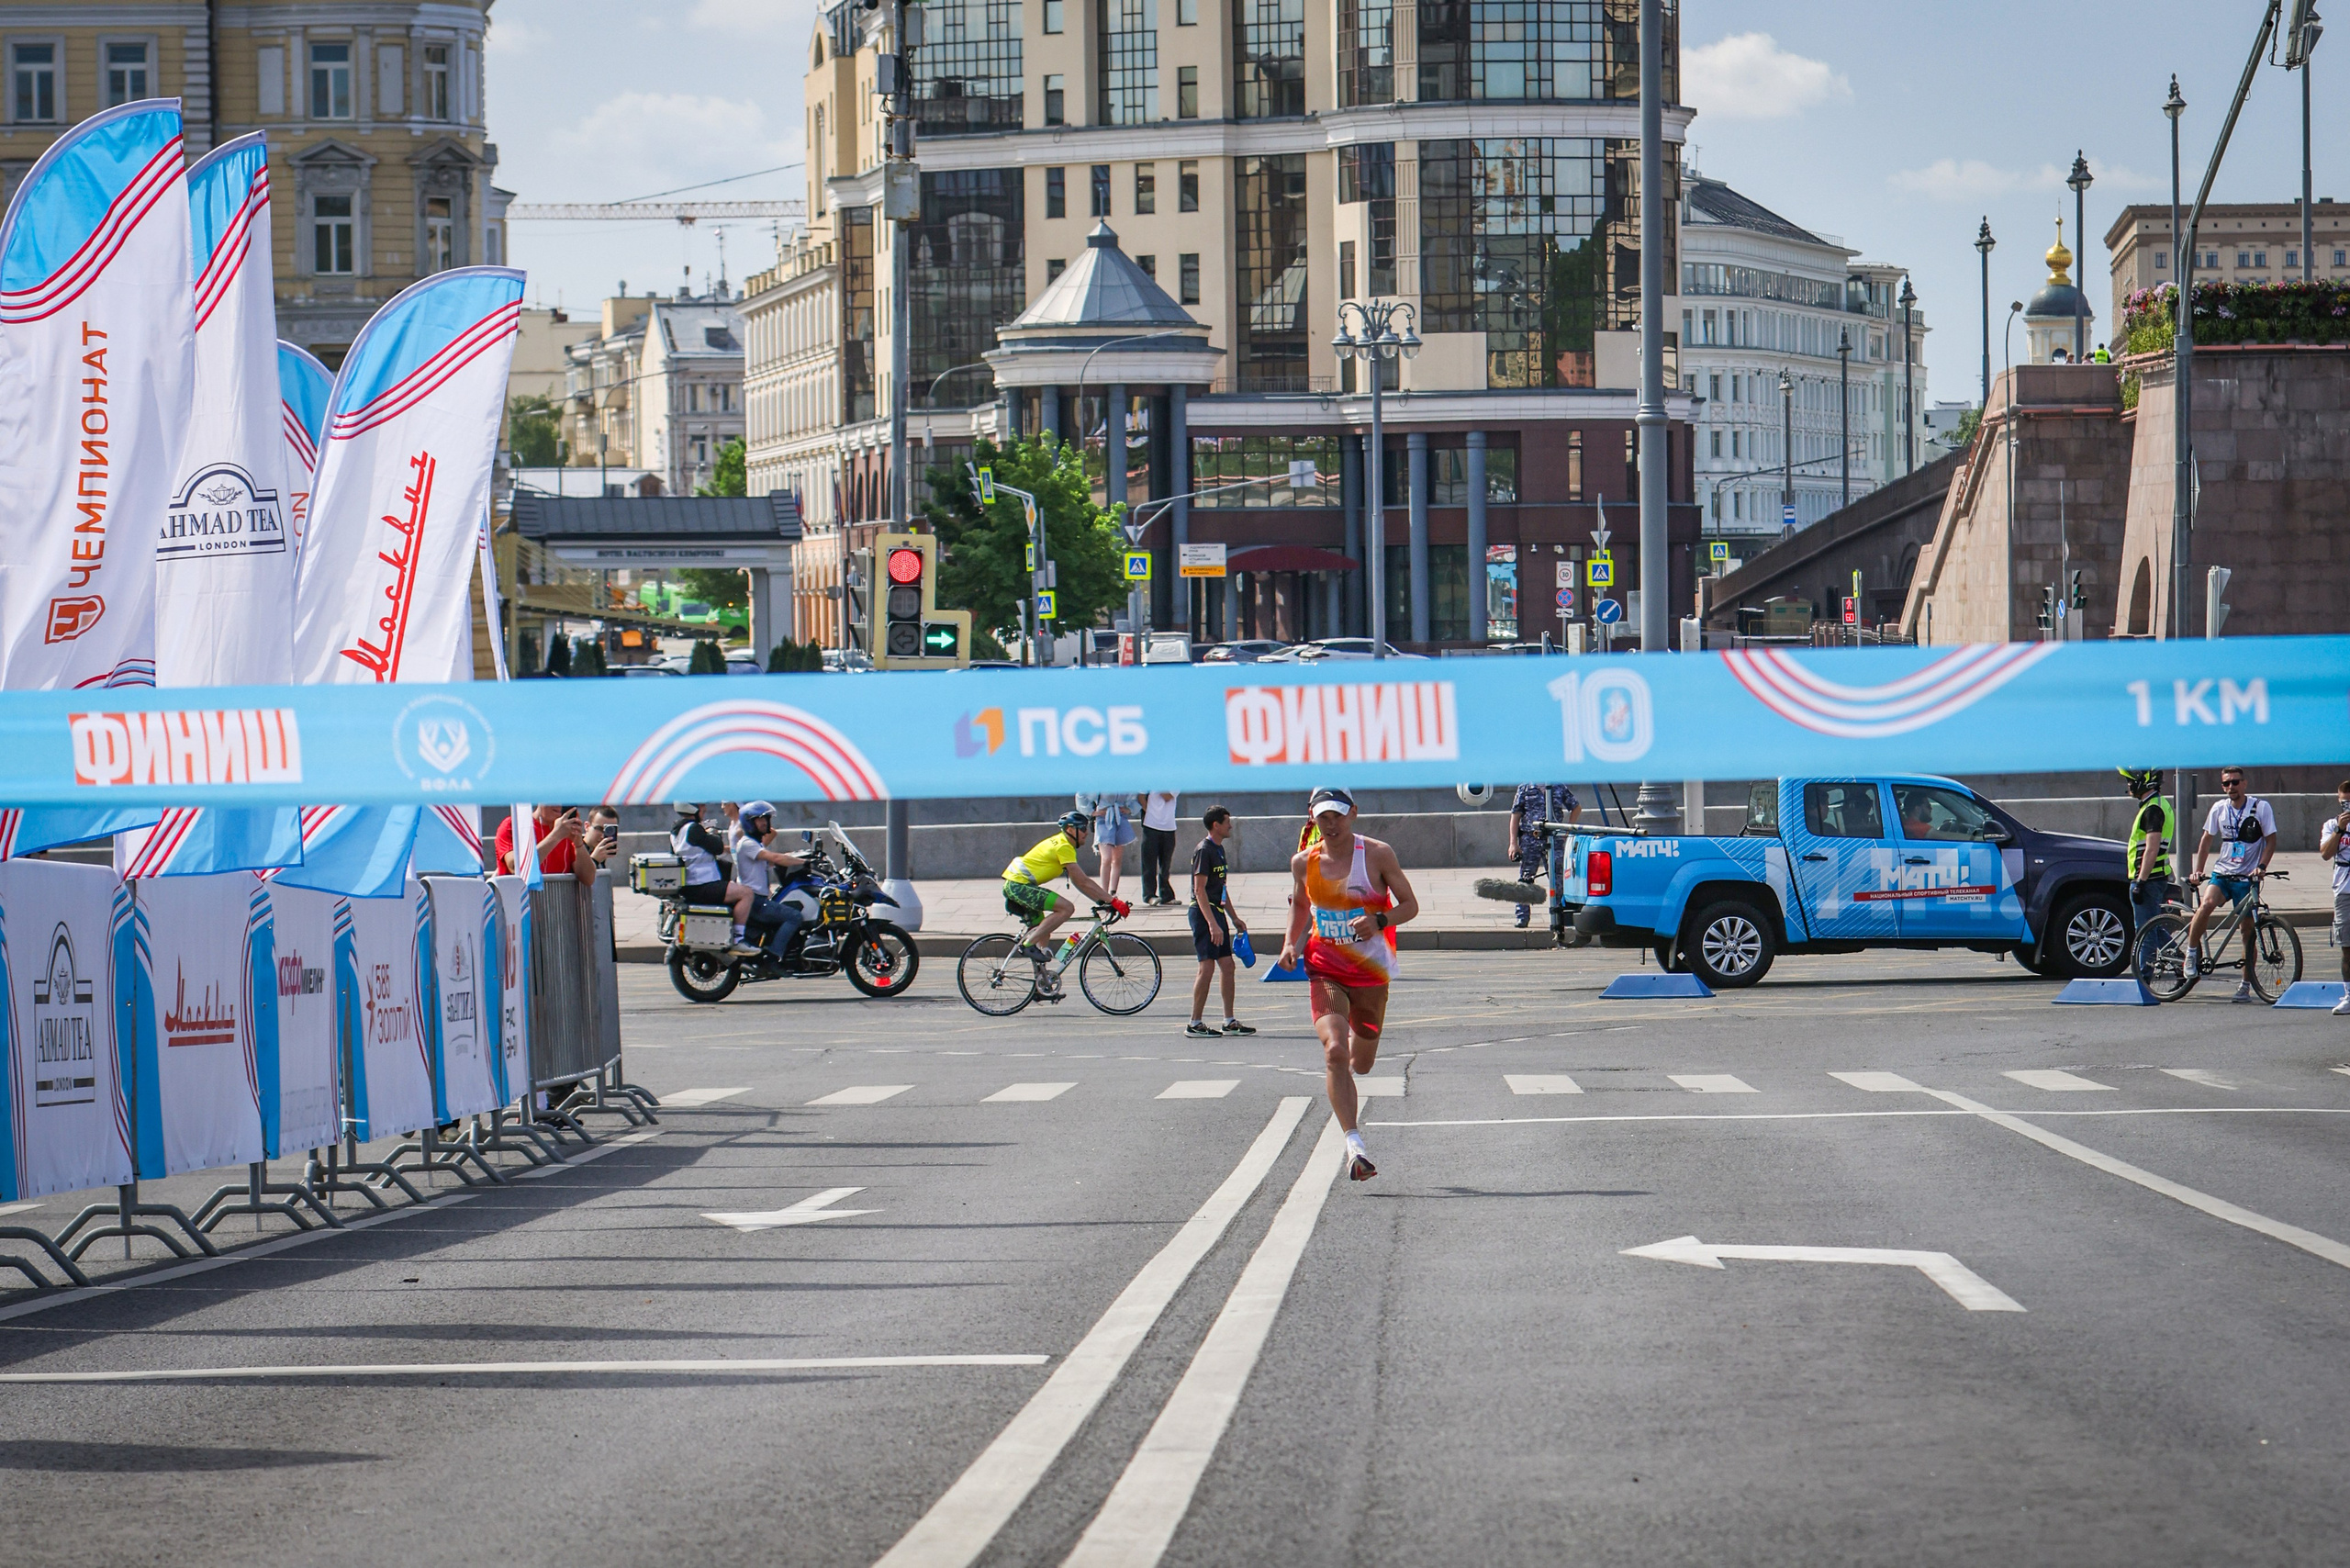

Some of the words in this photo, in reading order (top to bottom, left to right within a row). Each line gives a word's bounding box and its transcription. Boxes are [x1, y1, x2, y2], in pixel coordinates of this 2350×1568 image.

[68, 321, 108, 588] ЧЕМПИОНАТ
[247, 508, 279, 532] TEA
[199, 540, 247, 551] LONDON
[1546, 667, 1653, 763] 10
[2126, 679, 2152, 726] 1
[1016, 705, 1148, 756] ПСБ
[1225, 681, 1459, 766] ФИНИШ
[70, 709, 302, 786] ФИНИШ
[1616, 839, 1680, 858] МАТЧ!
[1869, 890, 1913, 900] НАЦИОНАЛЬНЫЙ
[1913, 889, 1949, 897] СПОРТИВНЫЙ
[1880, 865, 1971, 890] МАТЧ!
[375, 964, 391, 1000] 585
[71, 1016, 93, 1060] TEA
[53, 1076, 73, 1092] LONDON
